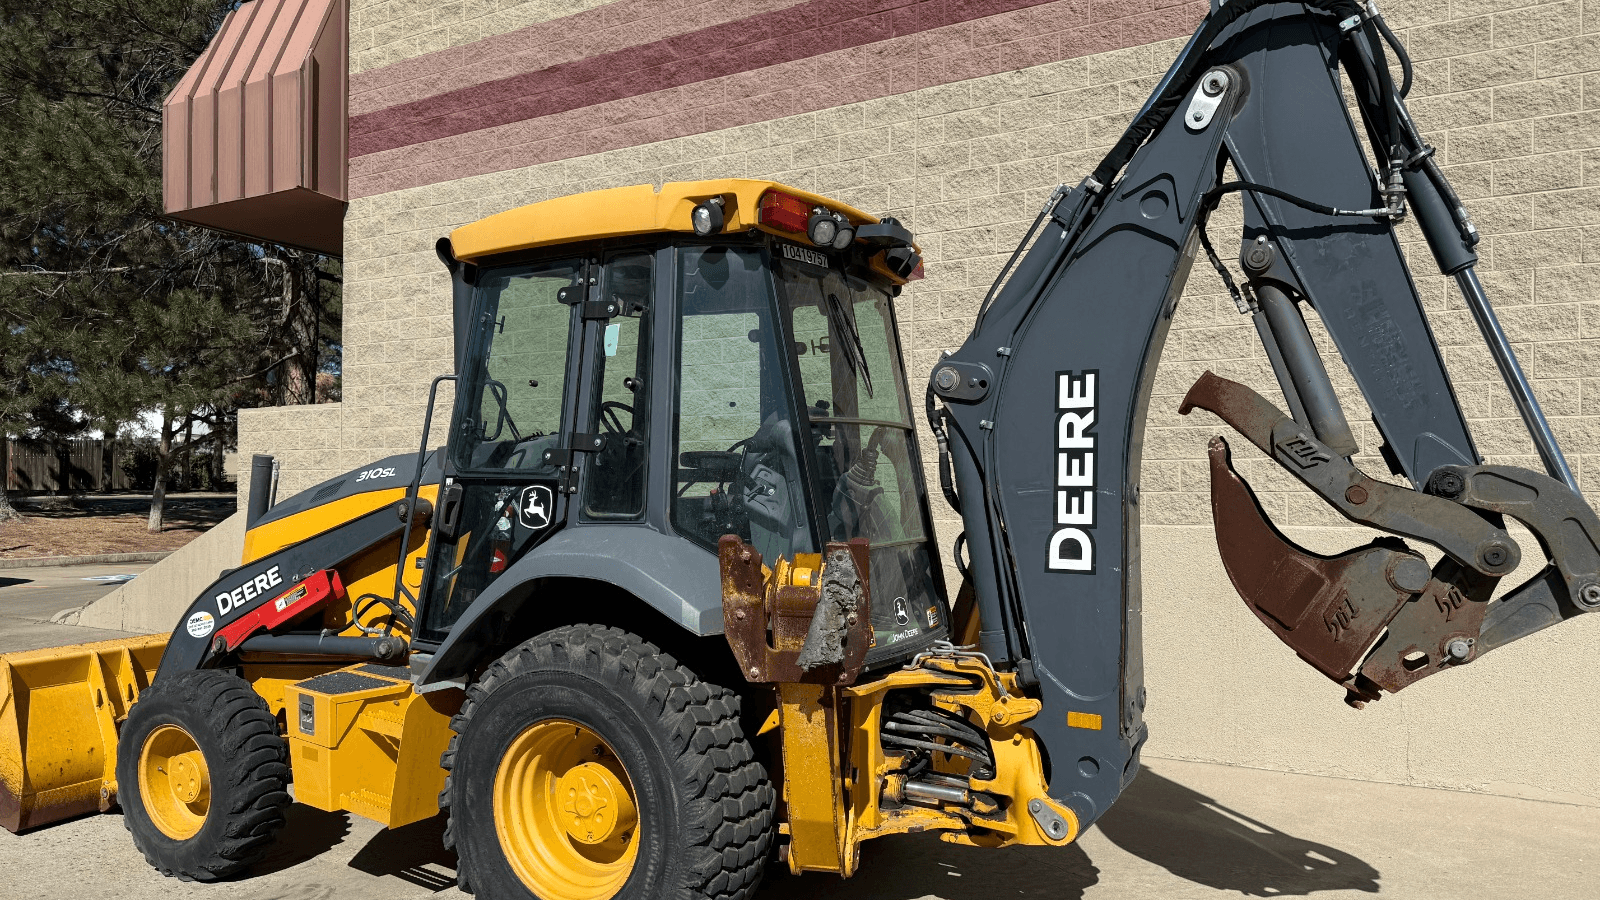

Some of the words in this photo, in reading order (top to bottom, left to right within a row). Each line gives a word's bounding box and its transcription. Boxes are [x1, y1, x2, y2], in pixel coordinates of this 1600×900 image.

[783, 244, 828, 268] 10419757
[355, 467, 396, 483] 310SL
[1048, 373, 1096, 572] DEERE
[215, 565, 283, 617] DEERE
[891, 632, 905, 643] JOHN
[904, 627, 919, 639] DEERE
